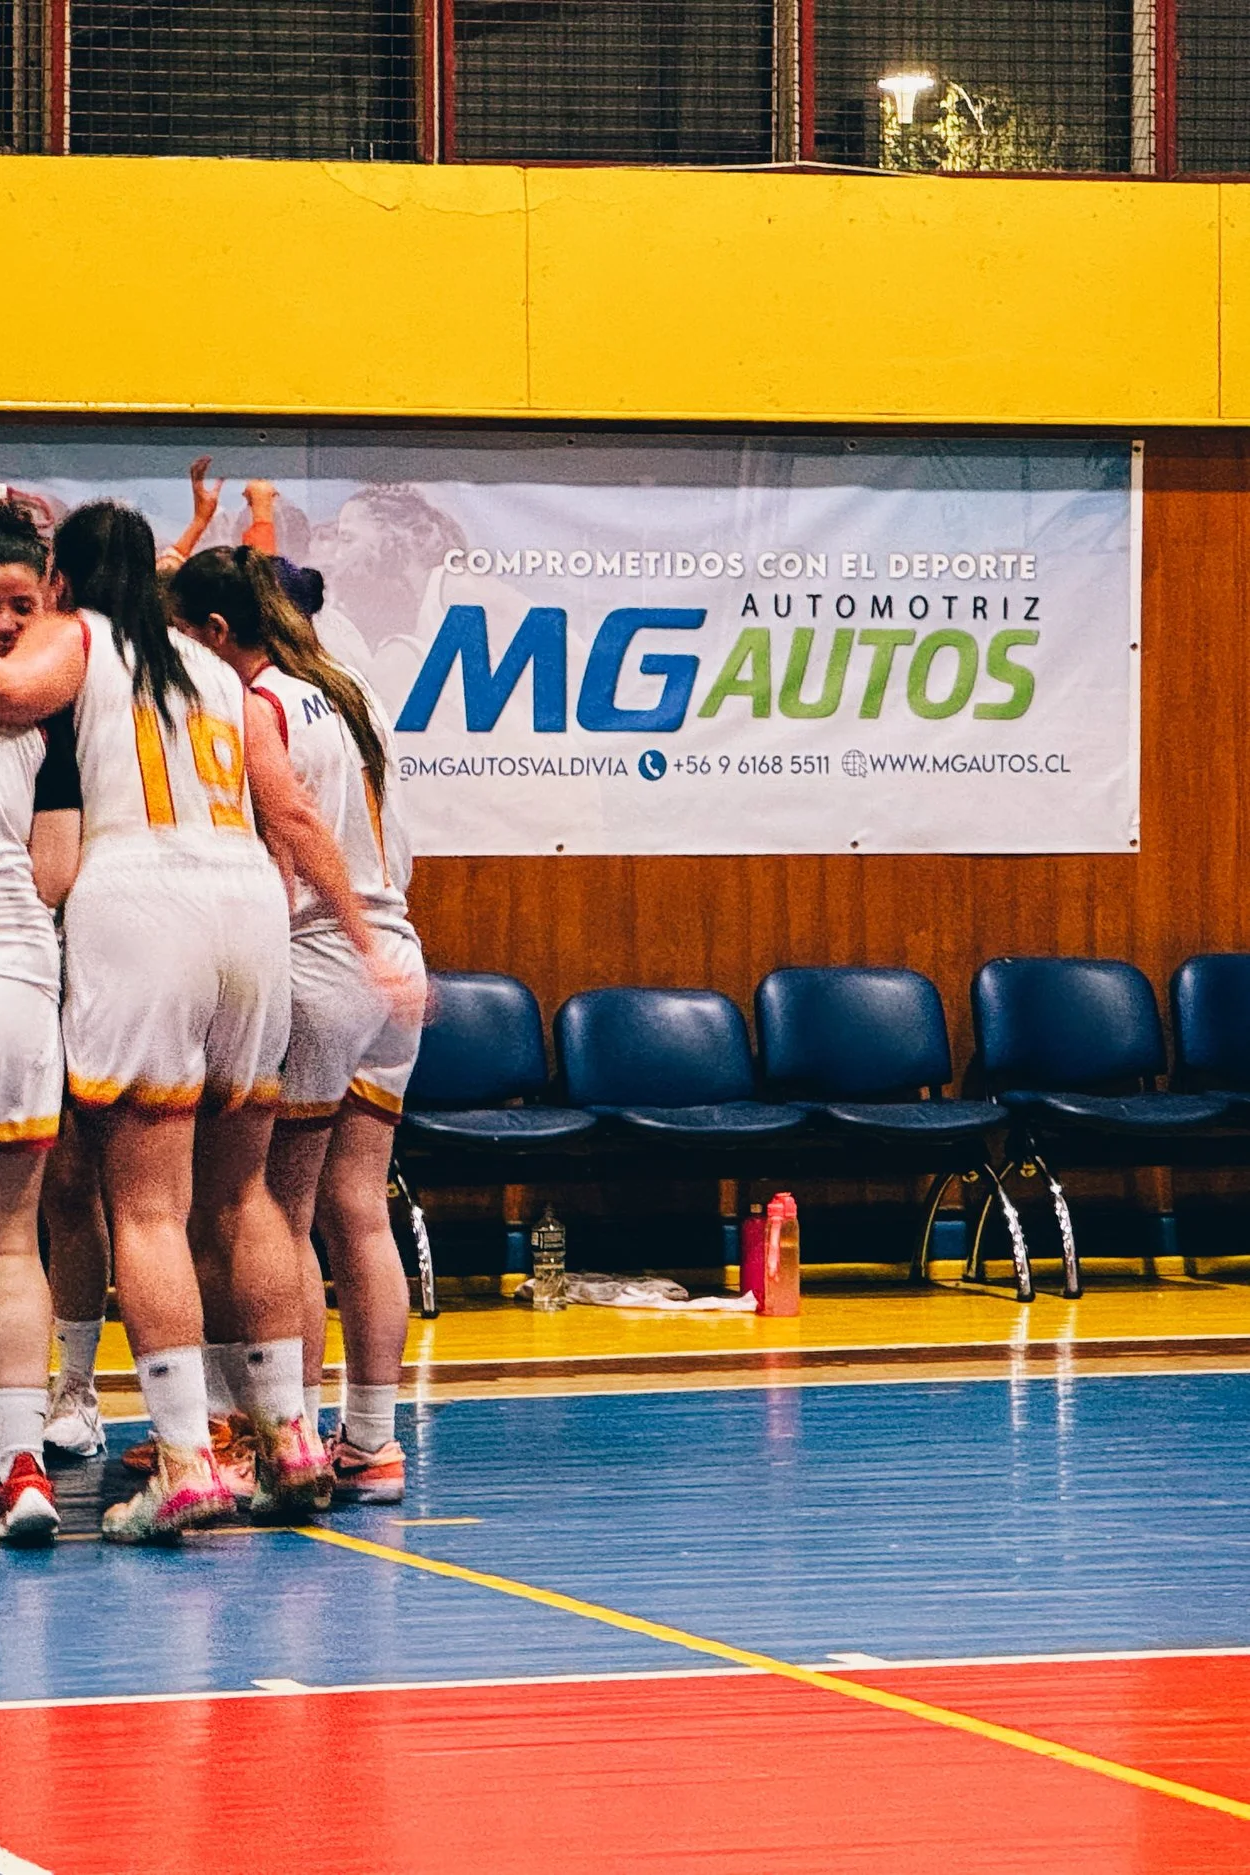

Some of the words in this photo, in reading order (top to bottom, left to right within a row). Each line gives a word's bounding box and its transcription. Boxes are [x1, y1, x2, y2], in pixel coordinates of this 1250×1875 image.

[444, 548, 745, 579] COMPROMETIDOS
[757, 551, 827, 579] CON
[841, 553, 876, 579] EL
[889, 553, 1036, 580] DEPORTE
[740, 592, 1040, 621] AUTOMOTRIZ
[399, 756, 629, 781] @MGAUTOSVALDIVIA
[673, 755, 711, 775] +56
[718, 755, 731, 775] 9
[737, 755, 783, 775] 6168
[790, 755, 829, 775] 5511
[869, 754, 1071, 773] WWW.MGAUTOS.CL
